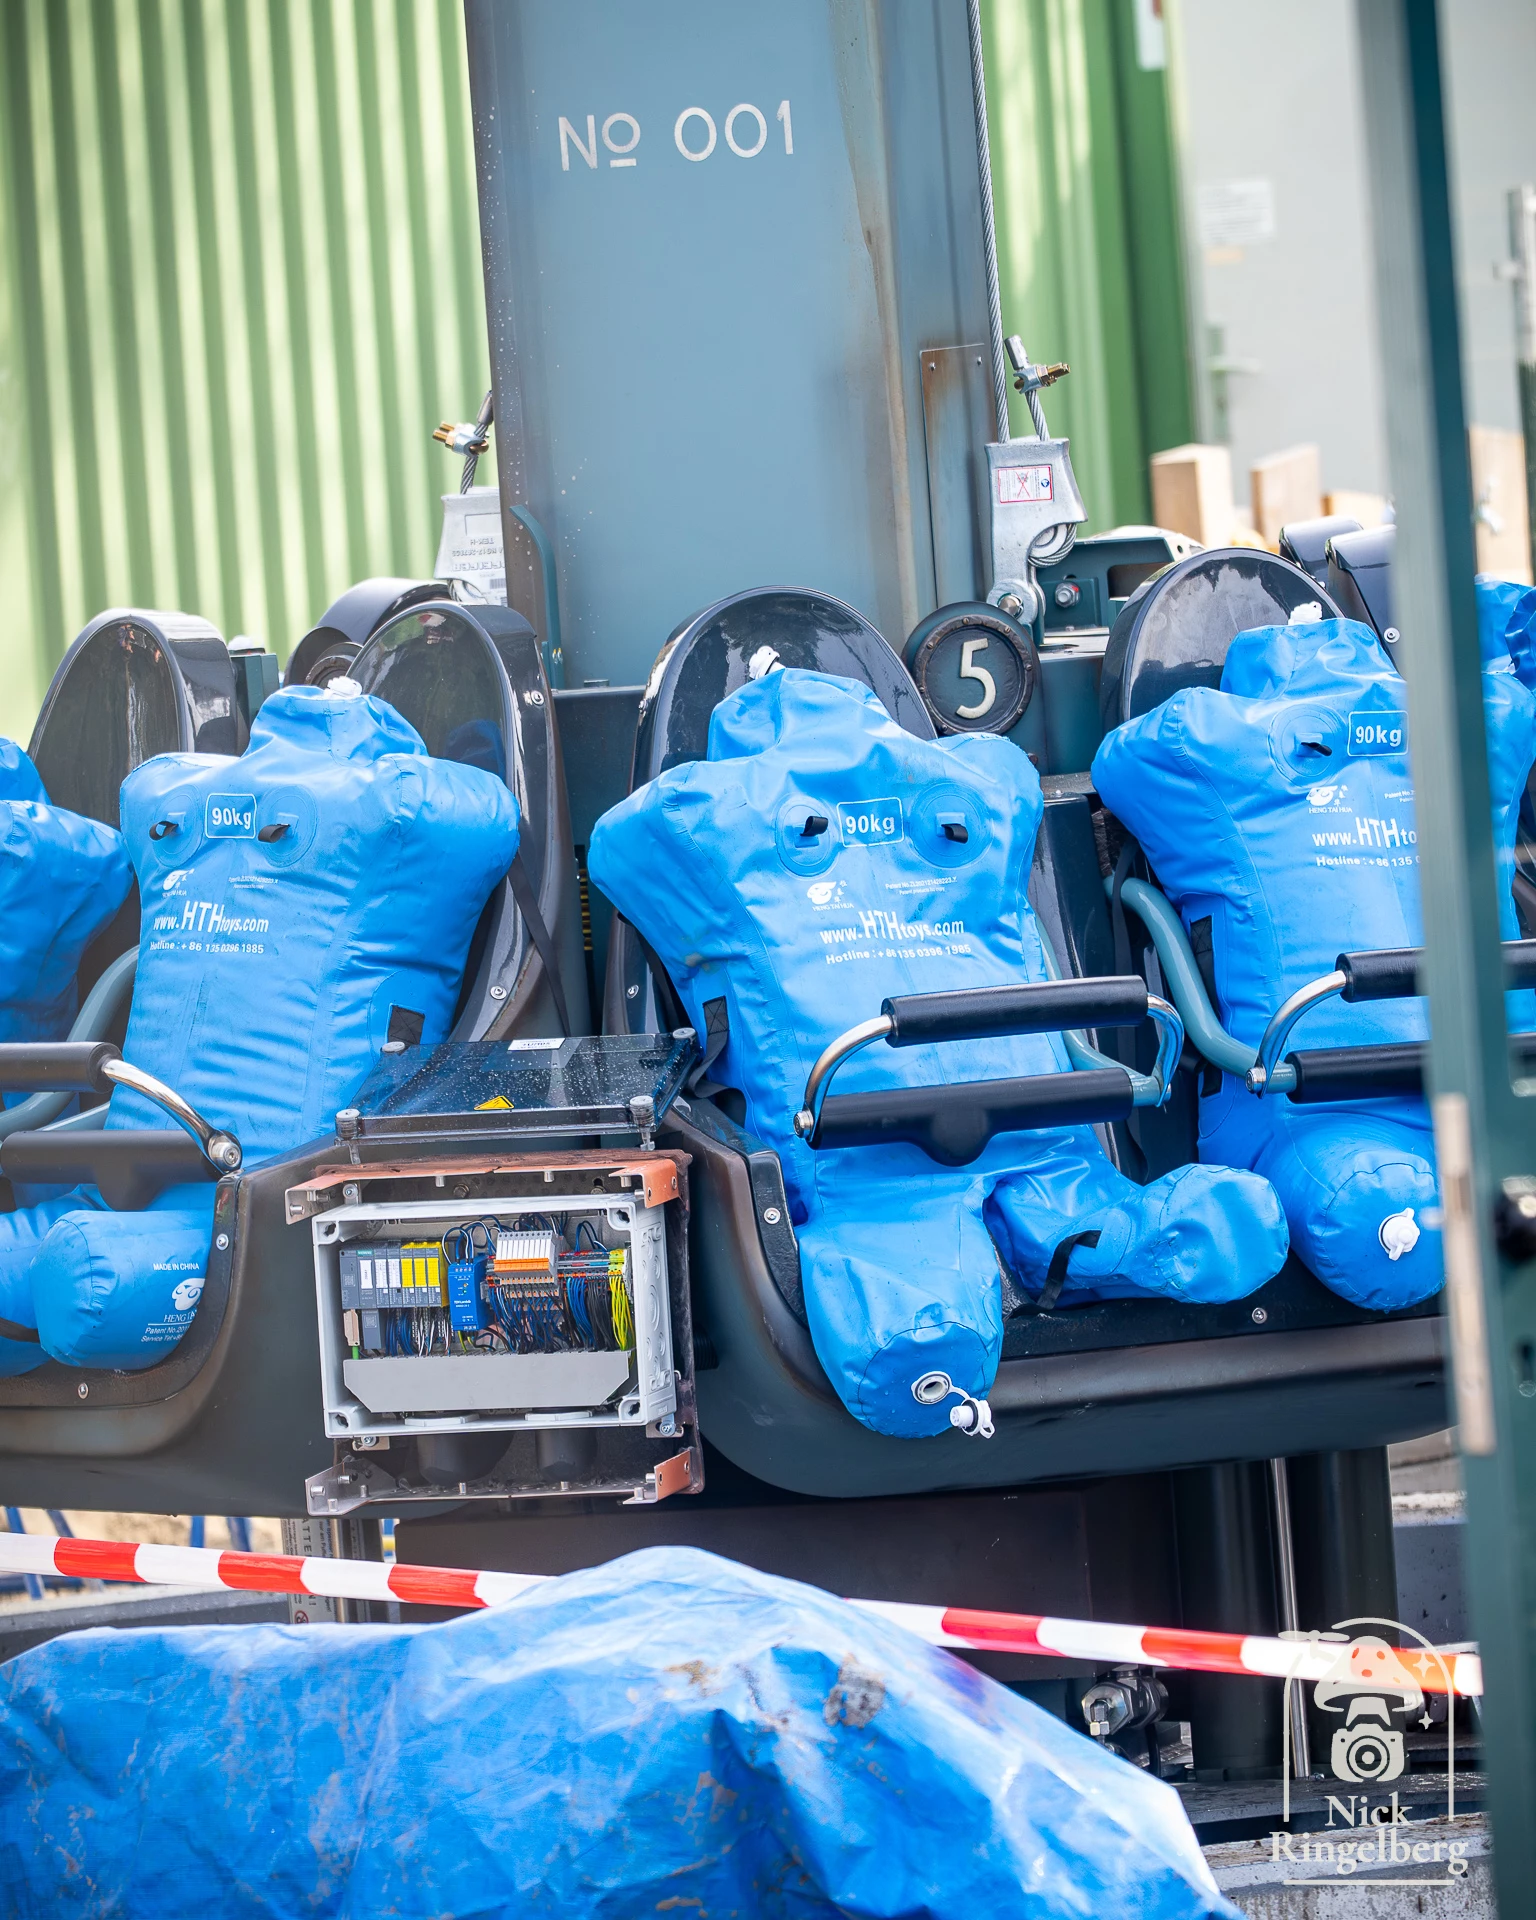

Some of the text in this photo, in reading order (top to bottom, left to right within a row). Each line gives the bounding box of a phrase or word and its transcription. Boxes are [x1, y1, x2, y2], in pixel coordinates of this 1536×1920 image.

[674, 100, 794, 162] 001
[956, 637, 997, 719] 5
[1355, 725, 1402, 747] 90kg
[211, 807, 251, 830] 90kg
[845, 814, 895, 834] 90kg
[1391, 856, 1412, 866] 135
[153, 900, 269, 935] www.HTHtoys.com
[820, 910, 964, 945] www.HTHtoys.com
[205, 943, 220, 953] 135
[242, 943, 264, 953] 1985
[945, 944, 971, 955] 1985
[164, 1314, 186, 1322] HENG
